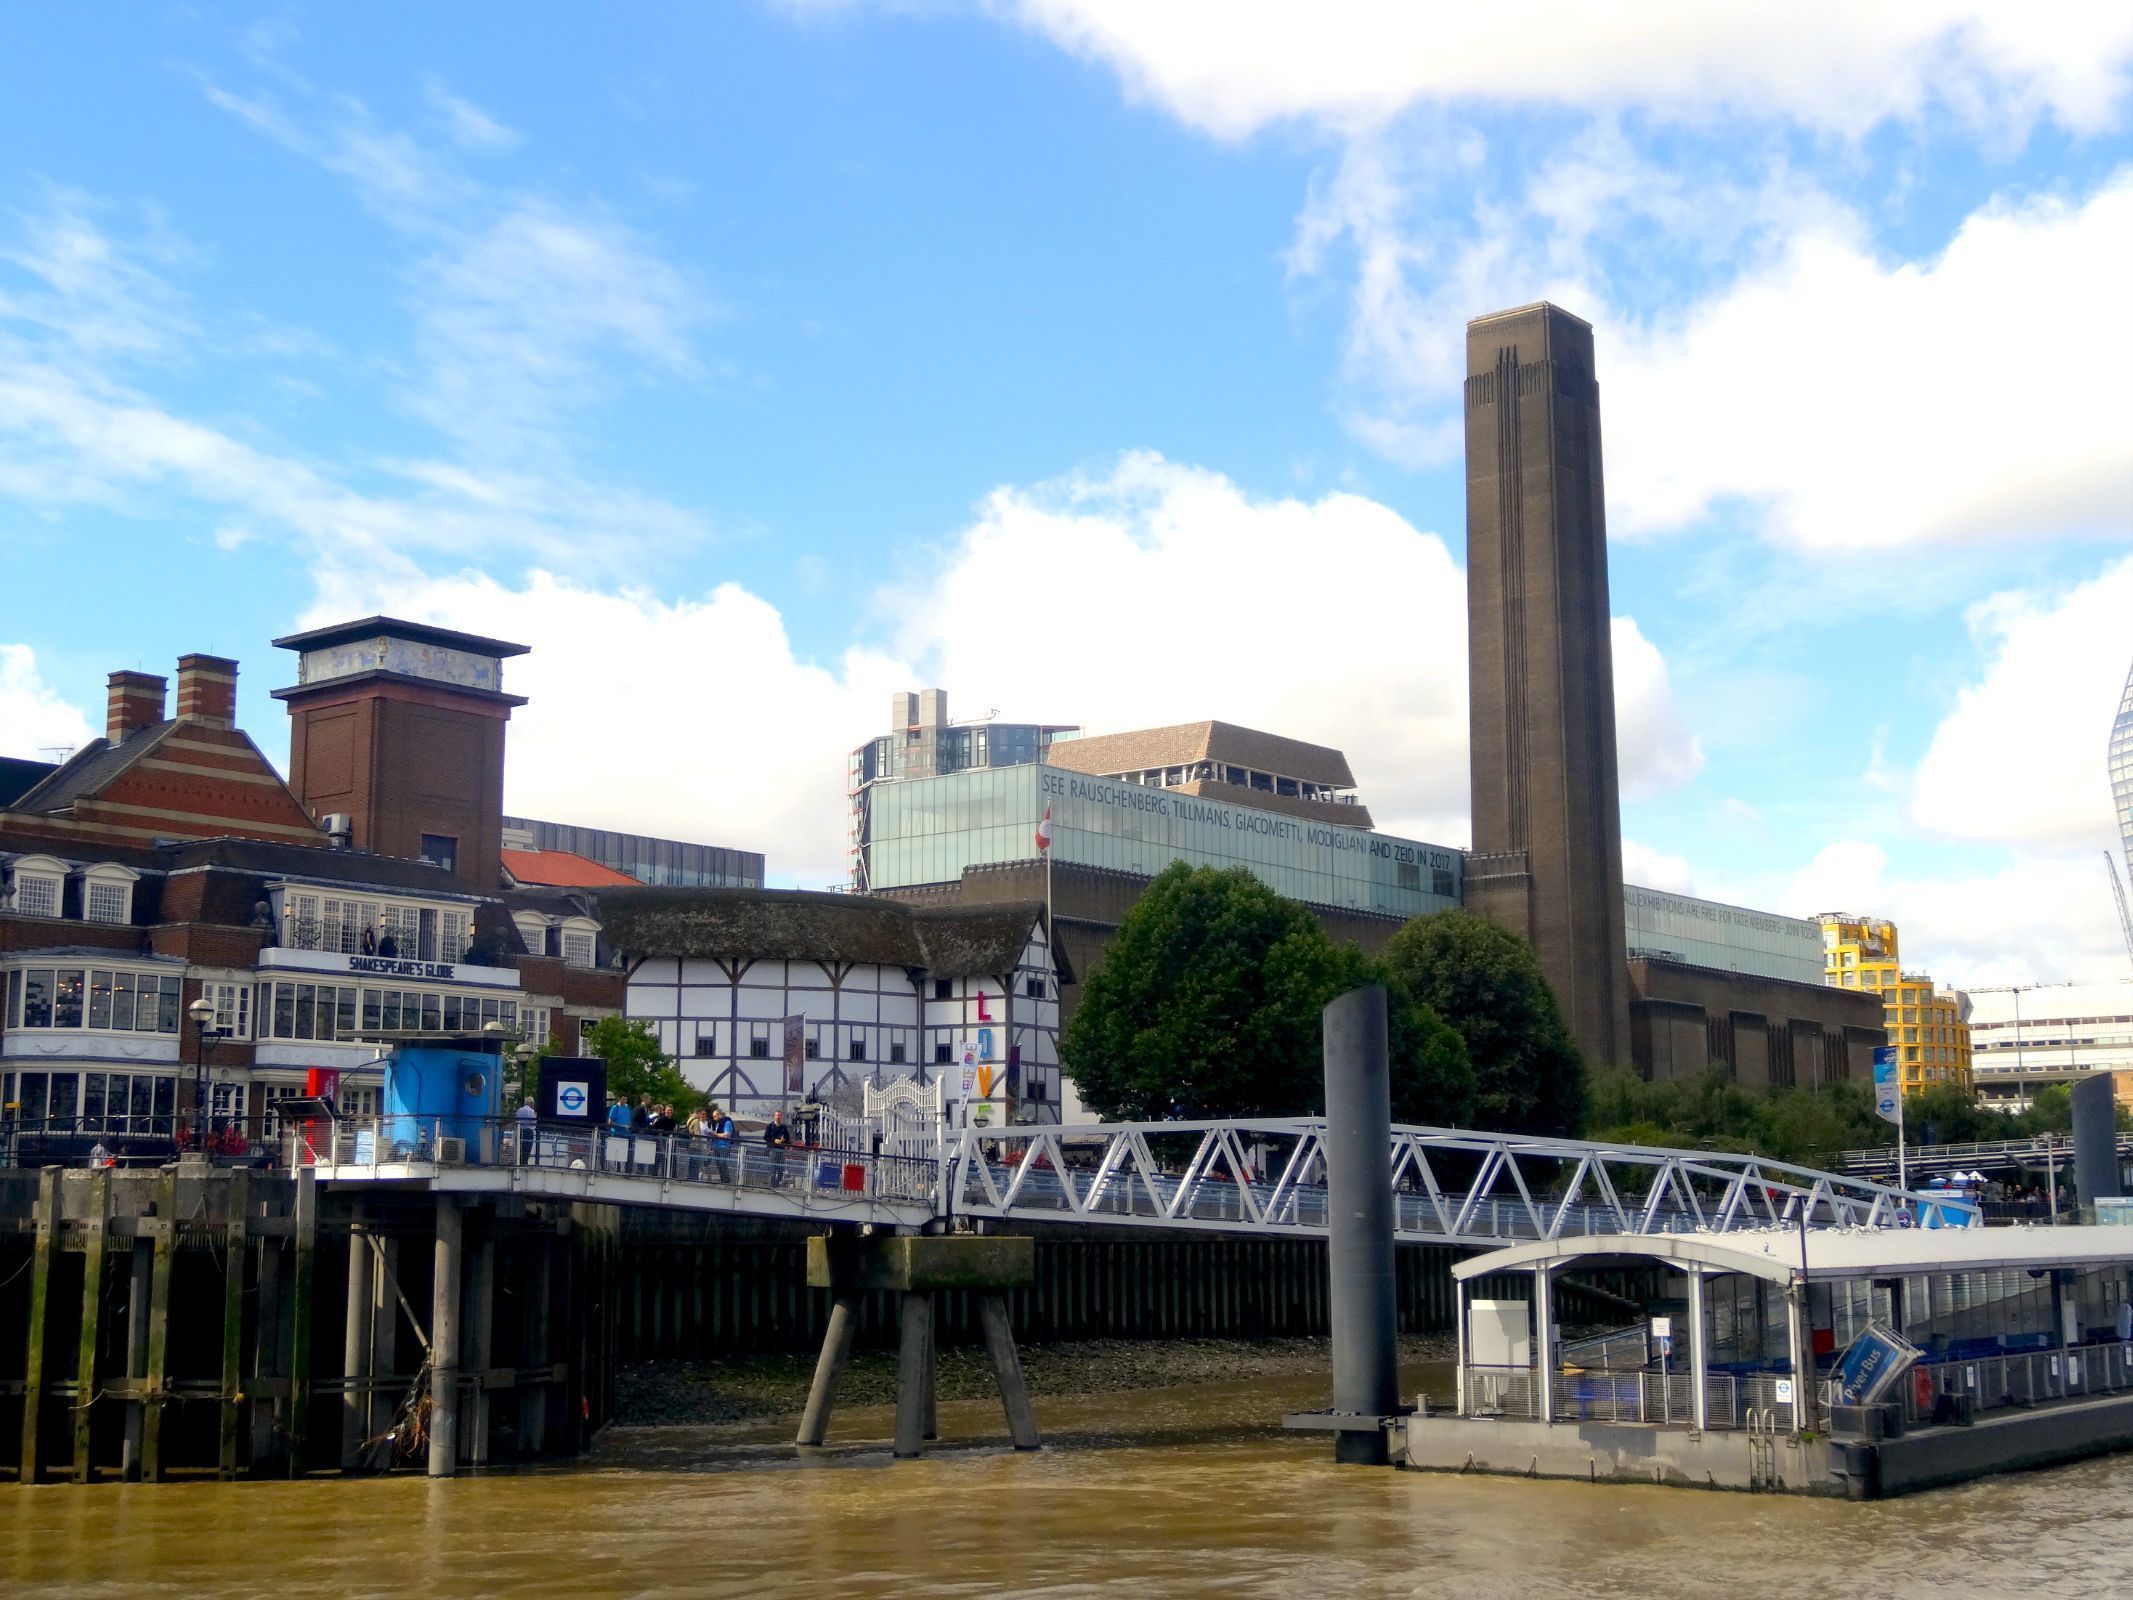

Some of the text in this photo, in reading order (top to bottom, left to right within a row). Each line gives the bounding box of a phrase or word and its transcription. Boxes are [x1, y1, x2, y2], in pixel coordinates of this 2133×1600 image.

[1042, 774, 1450, 869] SEE RAUSCHENBERG, TILLMANS, GIACOMETTI, MODIGLIANI AND ZEID IN 2017
[1637, 894, 1684, 915] EXHIBITIONS
[1687, 903, 1700, 918] ARE
[1702, 906, 1718, 921] FREE
[1719, 910, 1732, 924] FOR
[1734, 912, 1749, 928] TATE
[1750, 916, 1780, 934] MEMBERS
[349, 956, 455, 979] SHAKESPEARE'S GLOBE
[1861, 1349, 1881, 1372] Bus
